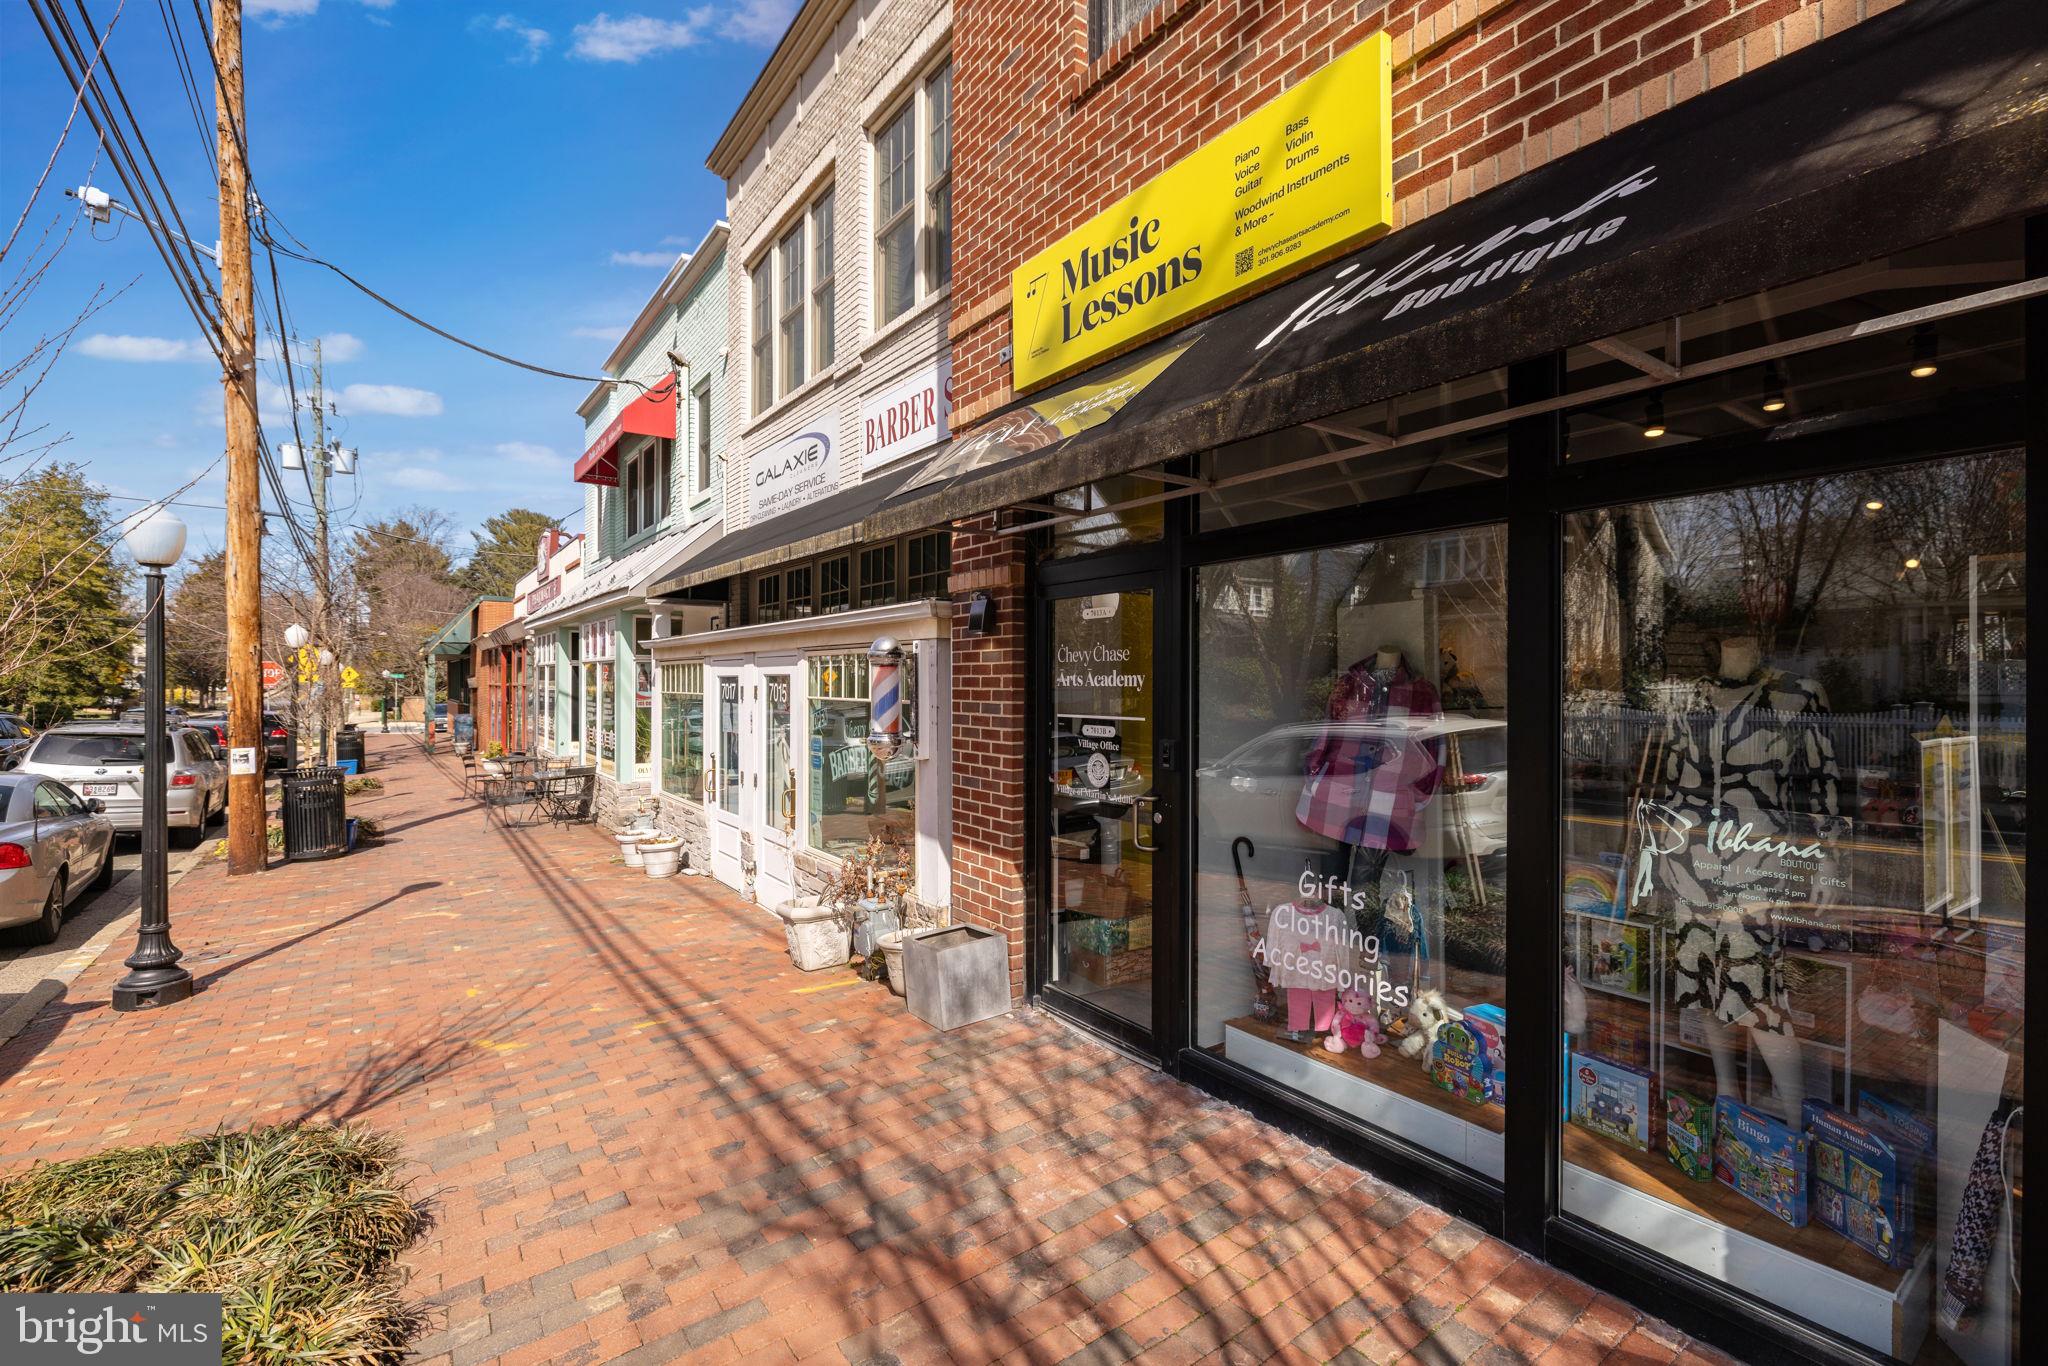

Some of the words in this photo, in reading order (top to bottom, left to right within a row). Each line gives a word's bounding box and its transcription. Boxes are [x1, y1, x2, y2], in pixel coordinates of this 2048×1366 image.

[1285, 115, 1310, 136] Bass
[1285, 129, 1314, 152] Violin
[1234, 145, 1260, 167] Piano
[1285, 144, 1319, 170] Drums
[1234, 161, 1260, 182] Voice
[1234, 175, 1263, 198] Guitar
[1235, 185, 1285, 221] Woodwind
[1286, 153, 1350, 194] Instruments
[1234, 225, 1242, 237] &
[1243, 213, 1268, 233] More
[1257, 207, 1351, 257] chevychaseartsacademy.com
[1061, 215, 1160, 300] Music
[1257, 241, 1302, 266] 301.906.9283
[1061, 244, 1203, 344] Lessons
[865, 387, 936, 455] BARBER
[755, 443, 818, 487] GALAXIE
[758, 487, 794, 510] SAME-DAY
[794, 472, 826, 495] SERVICE
[806, 482, 839, 500] ALTERATIONS
[721, 683, 736, 700] 7017
[769, 683, 788, 703] 7015
[1078, 738, 1099, 751] Village
[1099, 740, 1120, 751] Office
[829, 746, 868, 783] BARBER
[1693, 860, 1732, 874] Apparel
[1744, 867, 1805, 882] Accessories
[1819, 876, 1848, 889] Gifts
[1780, 858, 1825, 872] BOUTIQUE
[1298, 870, 1366, 910] Gifts
[1711, 878, 1729, 887] Mon
[1736, 882, 1749, 890] Sat
[1722, 889, 1737, 897] Sun
[1274, 903, 1380, 963] Clothing
[1770, 913, 1841, 931] www.ibhana.net
[1253, 937, 1409, 1008] Accessories
[1737, 1118, 1770, 1144] Bingo
[1811, 1114, 1843, 1137] Human
[1843, 1130, 1883, 1157] Anatomy
